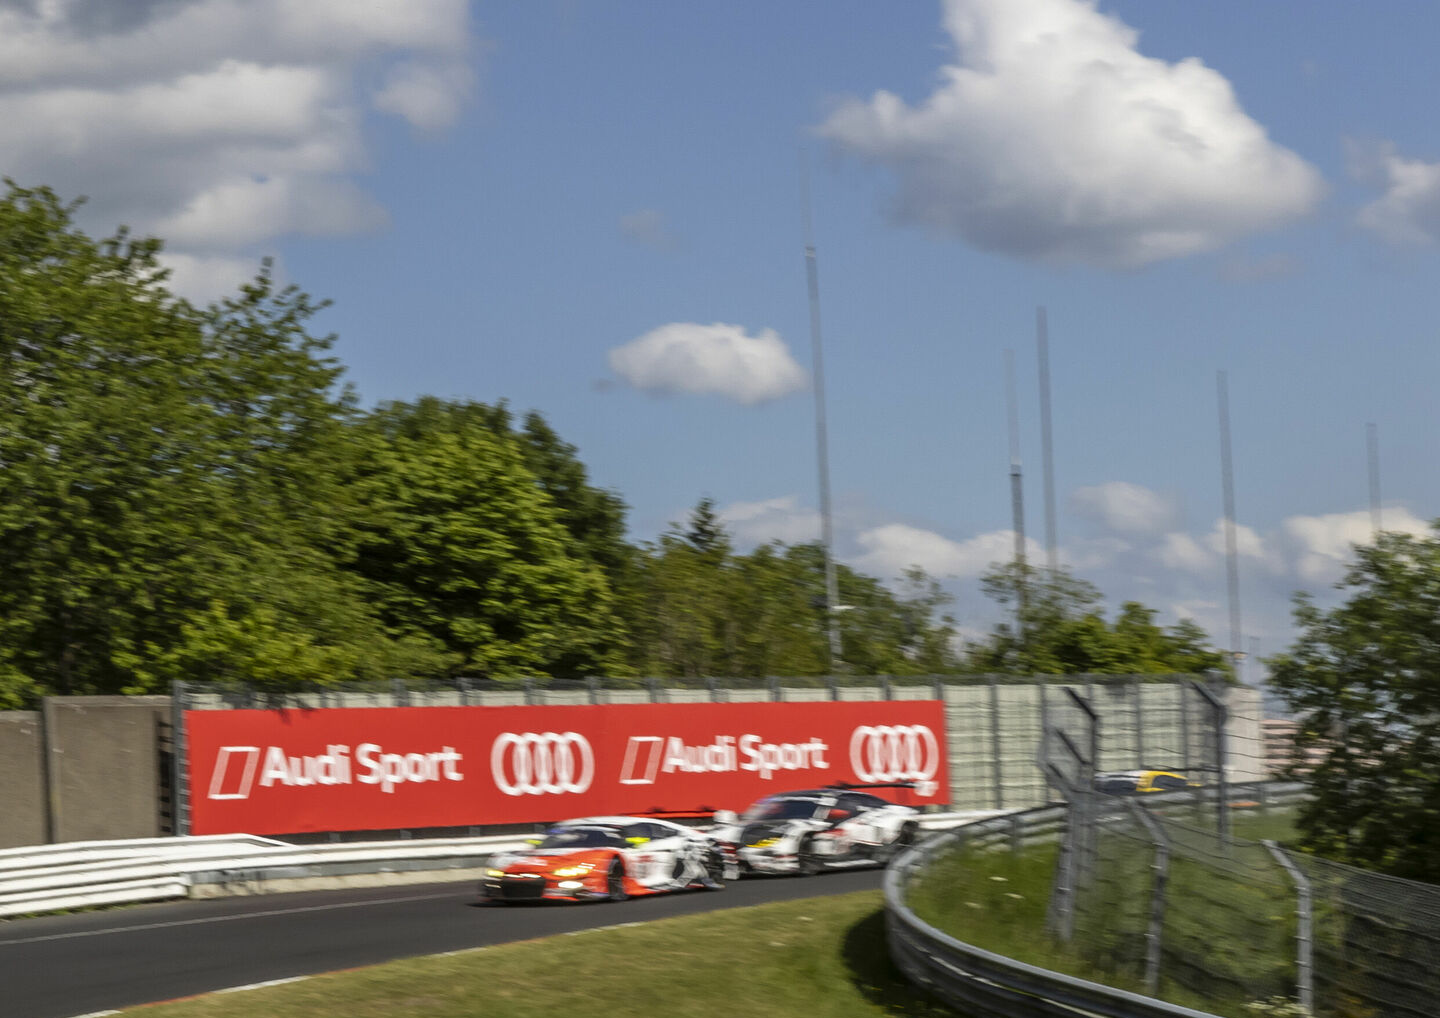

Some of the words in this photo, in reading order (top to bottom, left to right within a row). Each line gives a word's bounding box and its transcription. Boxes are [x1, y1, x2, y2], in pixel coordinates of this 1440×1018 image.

[259, 744, 352, 786] Audi
[356, 743, 464, 793] Sport
[662, 735, 737, 773] Audi
[739, 734, 830, 780] Sport
